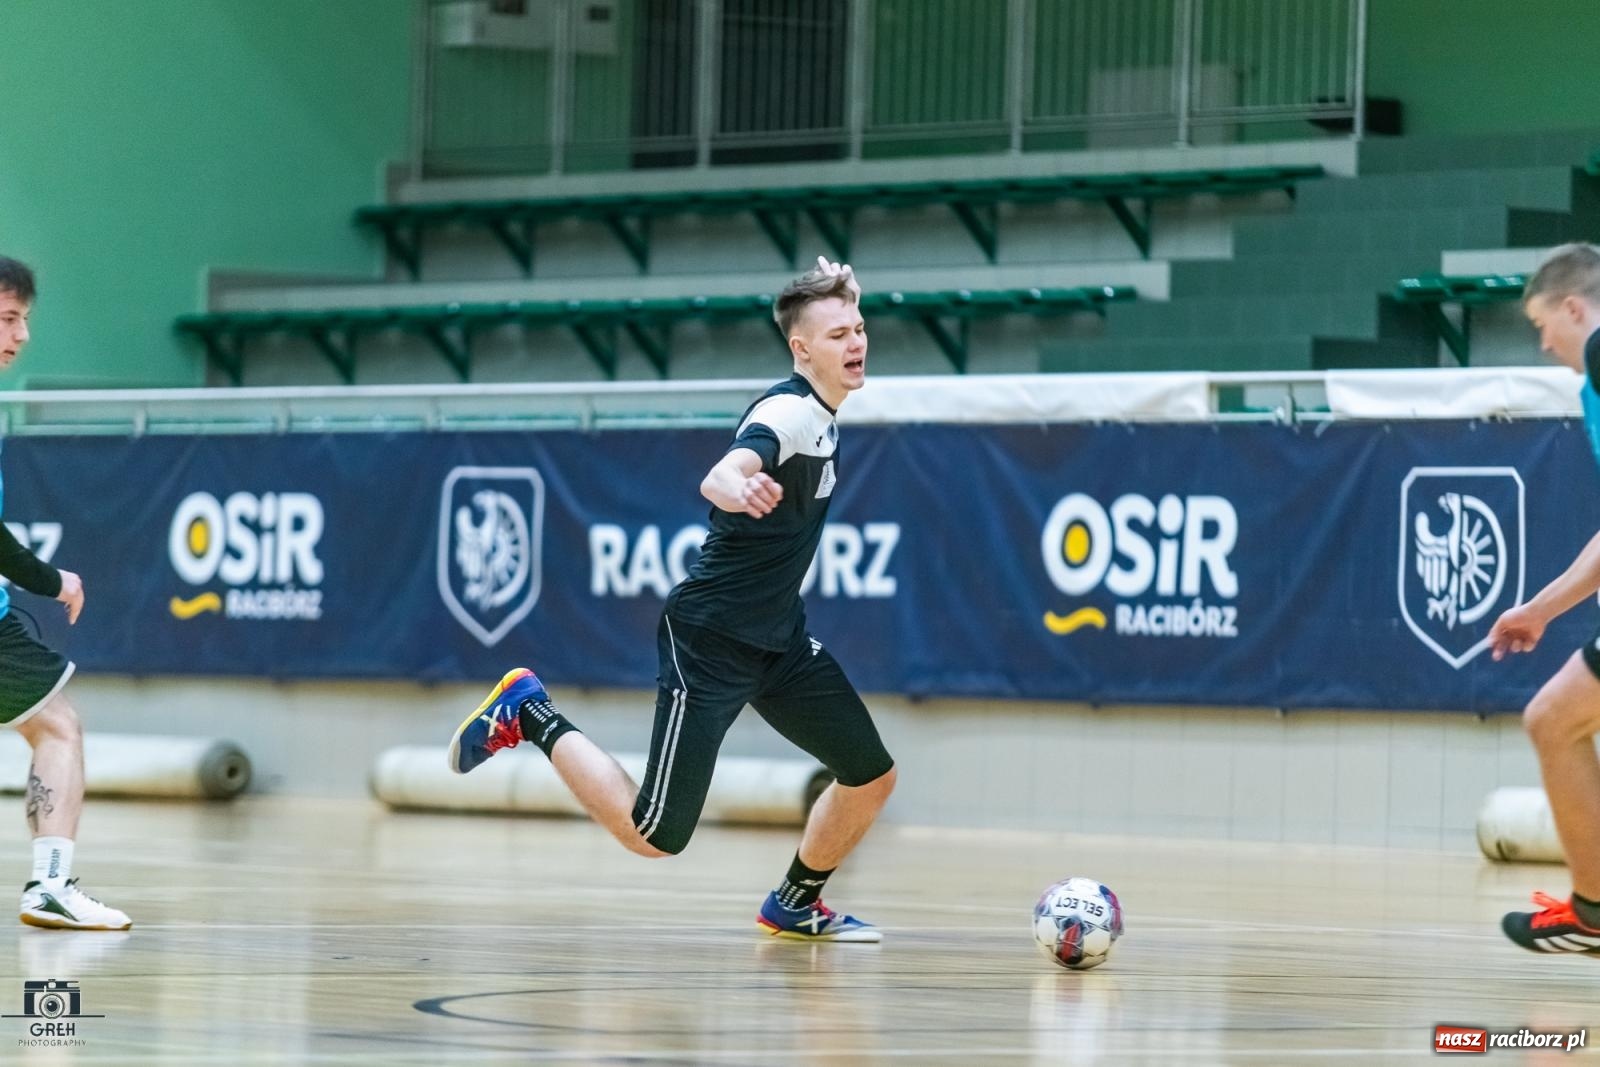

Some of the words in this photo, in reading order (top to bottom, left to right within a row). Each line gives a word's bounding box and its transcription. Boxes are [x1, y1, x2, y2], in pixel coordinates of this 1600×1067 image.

[589, 523, 901, 597] RACRZ
[1115, 598, 1239, 637] RACIBÓRZ
[1055, 897, 1104, 917] SELECT
